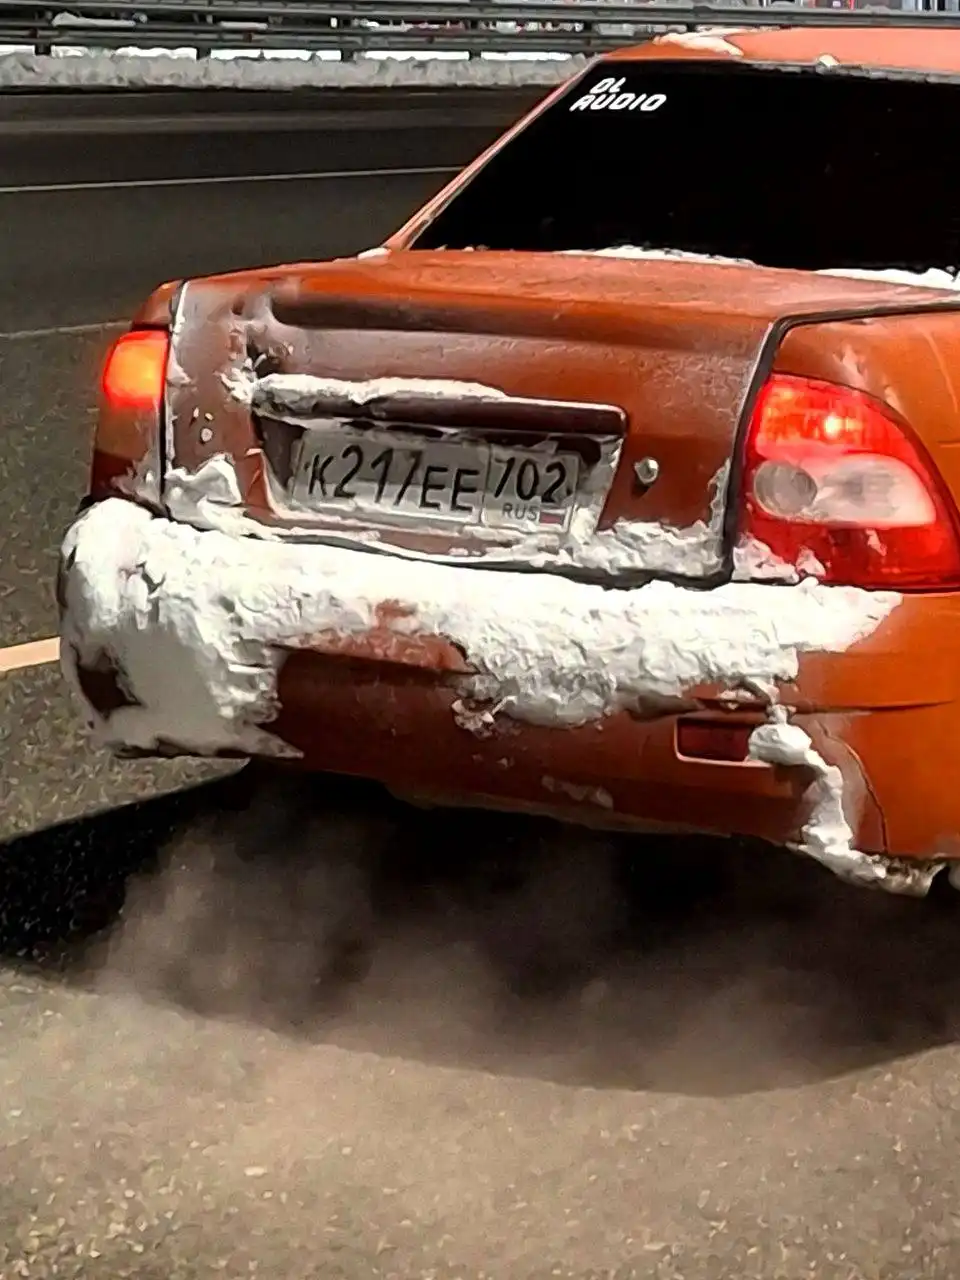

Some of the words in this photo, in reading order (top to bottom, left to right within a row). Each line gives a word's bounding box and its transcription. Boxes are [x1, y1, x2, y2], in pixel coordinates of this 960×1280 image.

[569, 93, 667, 111] AUDIO
[494, 456, 570, 503] 702
[502, 502, 539, 521] RUS
